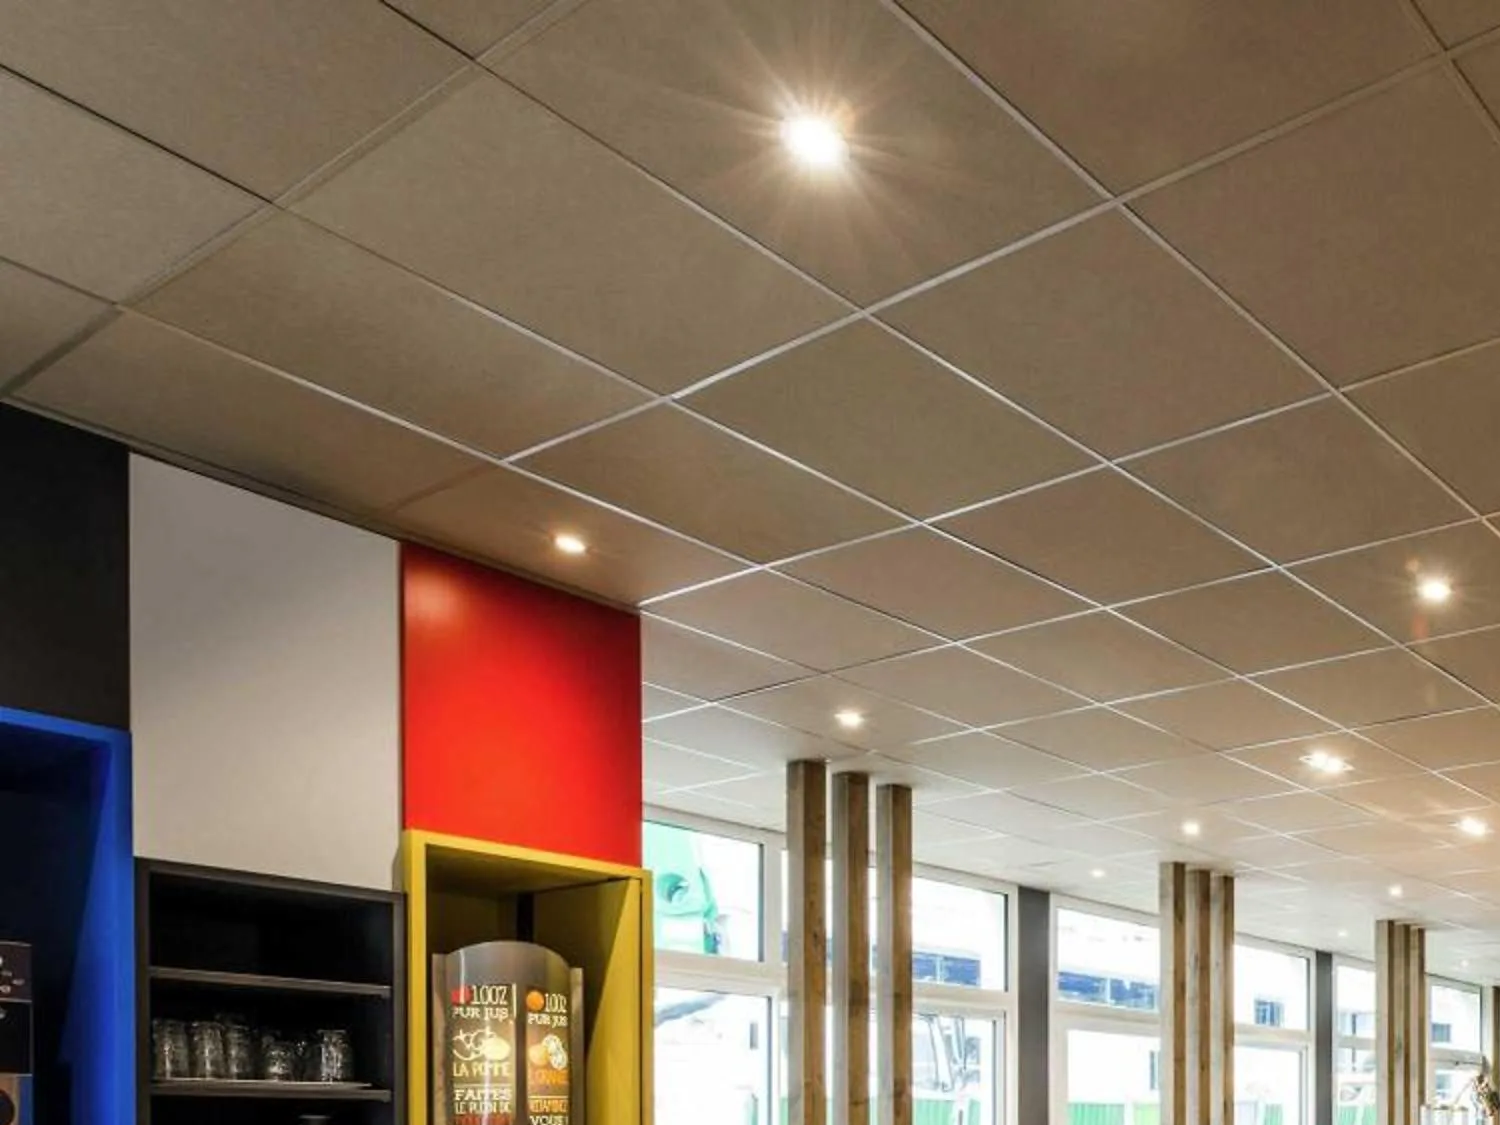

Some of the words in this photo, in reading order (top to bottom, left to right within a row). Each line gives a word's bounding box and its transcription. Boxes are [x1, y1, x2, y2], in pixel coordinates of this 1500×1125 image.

[452, 1007, 480, 1018] PUR
[484, 1007, 509, 1021] JUS
[527, 1013, 551, 1025] PUR
[453, 1062, 469, 1077] LA
